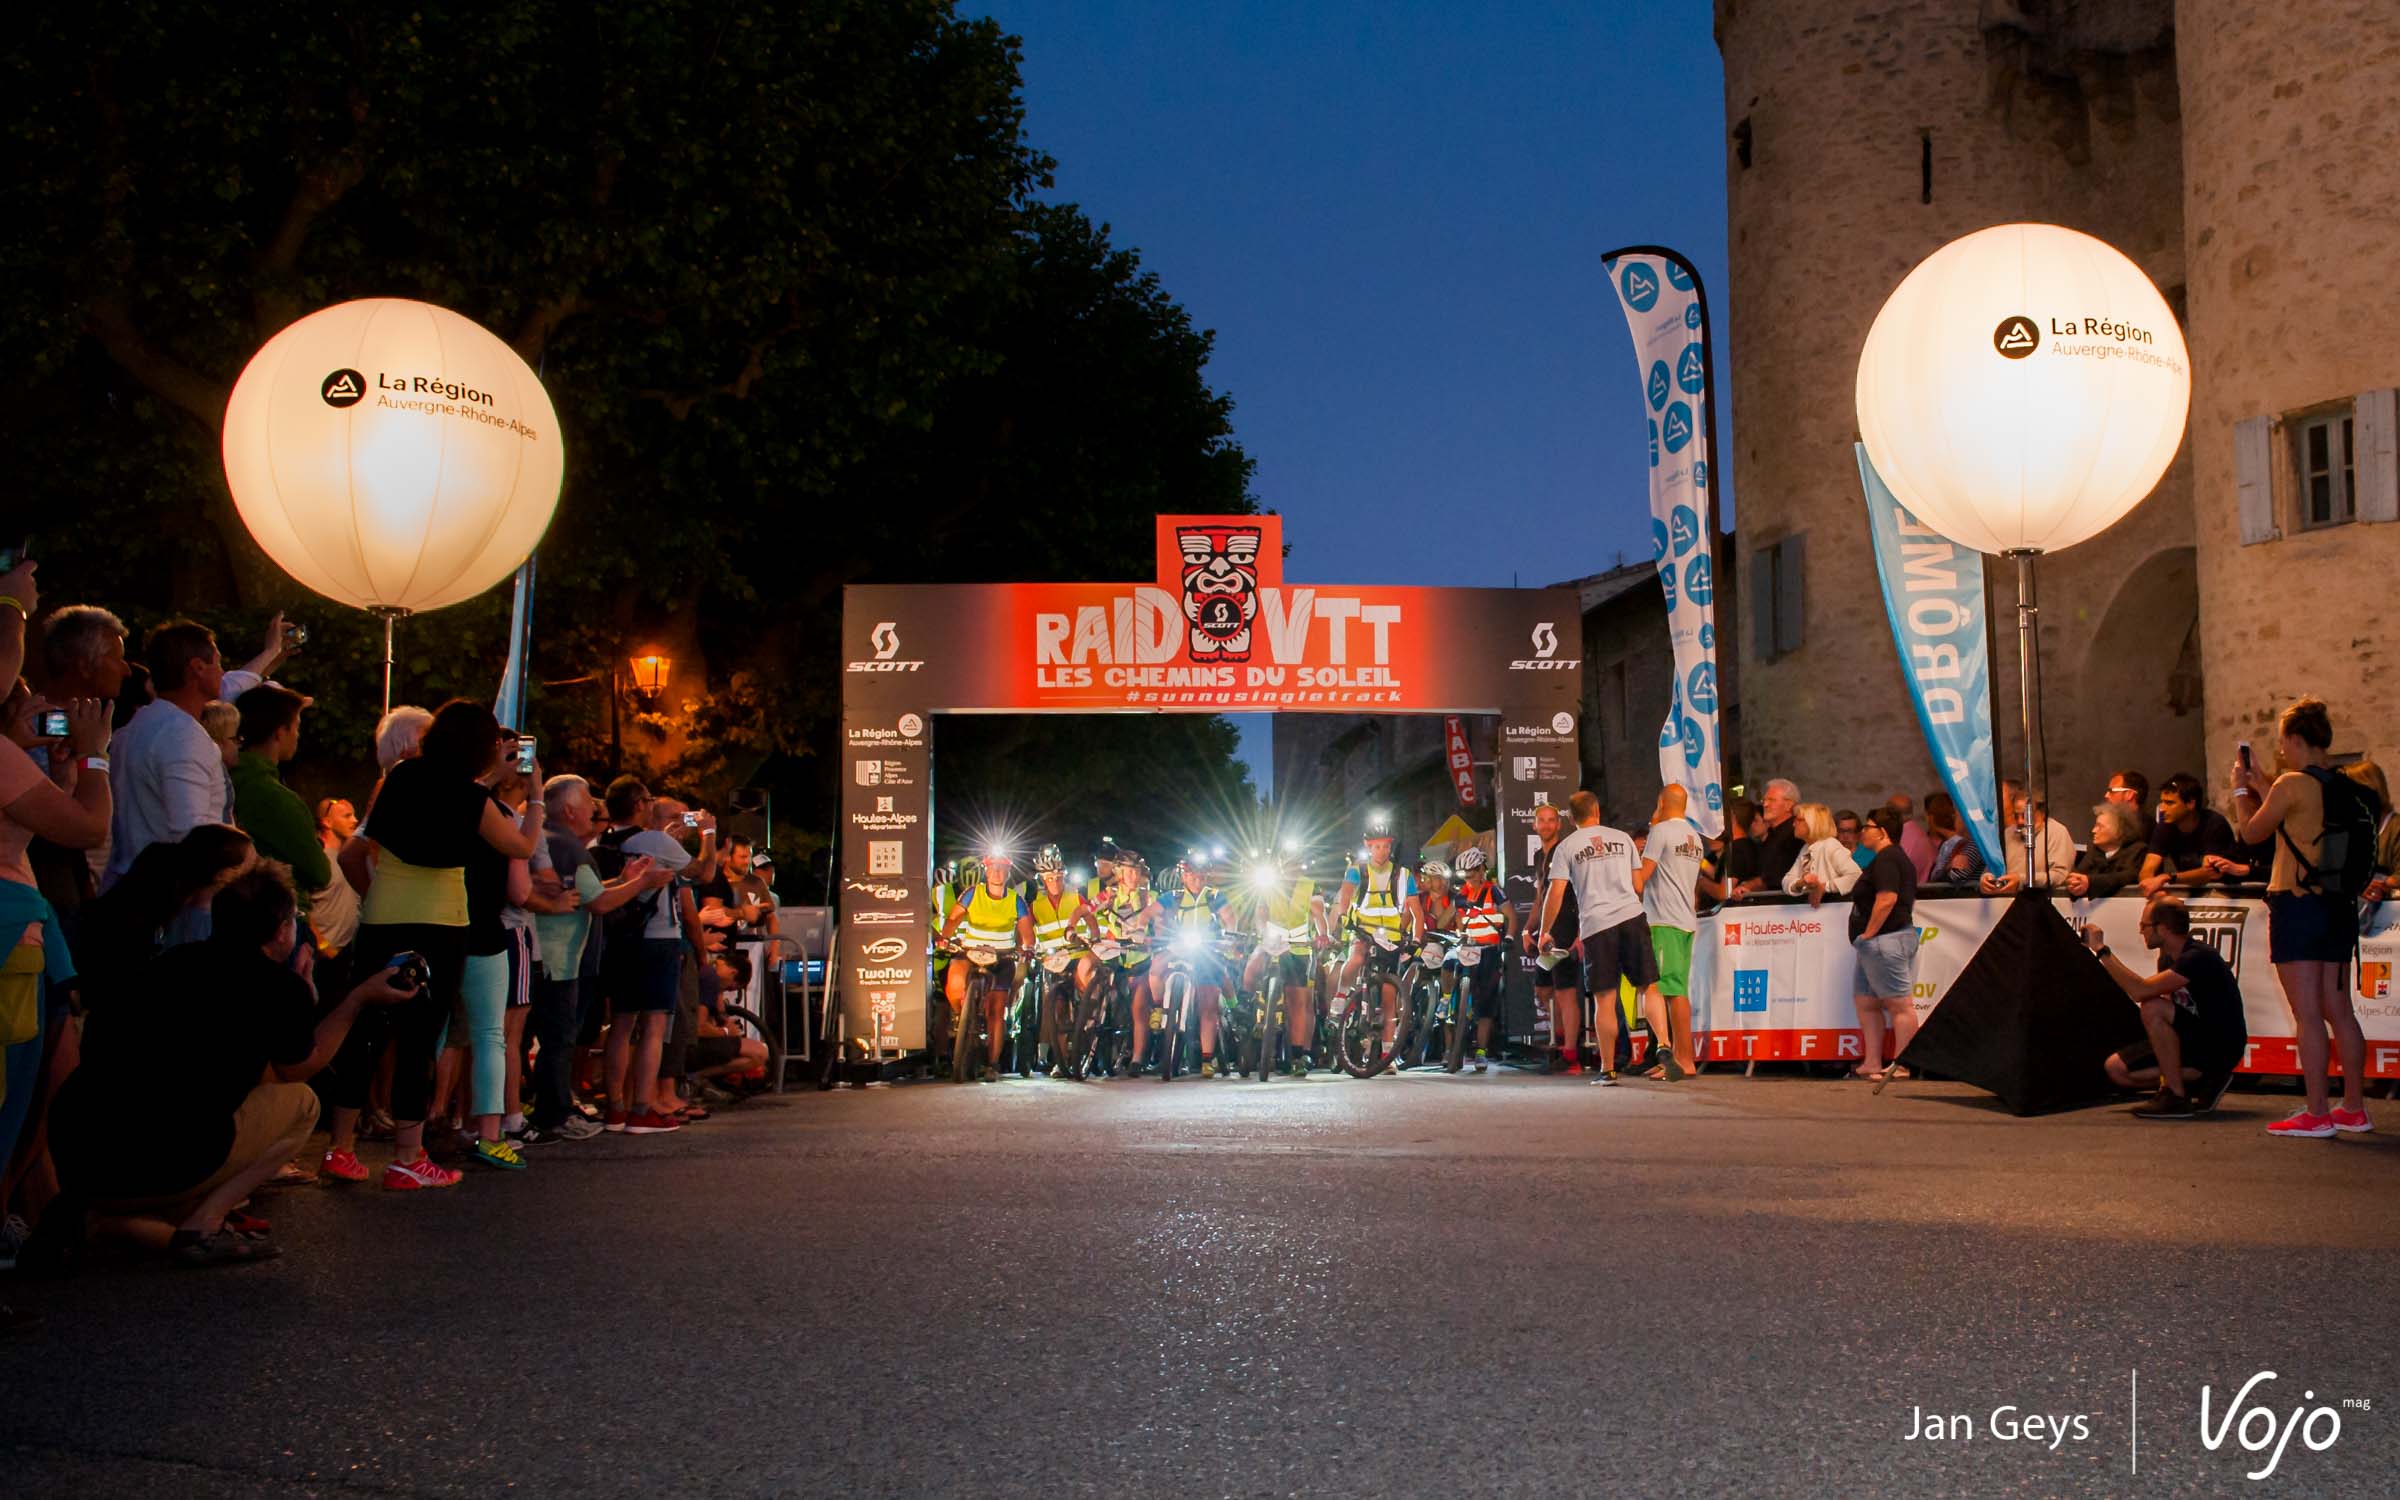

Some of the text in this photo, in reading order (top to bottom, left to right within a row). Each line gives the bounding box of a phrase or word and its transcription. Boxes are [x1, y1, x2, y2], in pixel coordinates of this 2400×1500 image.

[2052, 318, 2153, 344] La Région
[378, 373, 494, 406] La Région
[377, 395, 538, 441] Auvergne-Rhône-Alpes
[1036, 587, 1401, 664] RAID VTT
[846, 661, 924, 672] SCOTT
[1508, 660, 1581, 670] SCOTT
[1037, 667, 1401, 688] LES CHEMINS DU SOLEIL
[1125, 690, 1402, 705] #sunnysingletrack
[848, 728, 898, 739] La Région
[1506, 726, 1551, 737] La Région
[1447, 718, 1475, 802] TABAC
[852, 813, 918, 825] Hautes-Alpes
[1604, 841, 1625, 853] VTT
[874, 887, 909, 902] Gap
[1744, 919, 1822, 937] Hautes-Alpes
